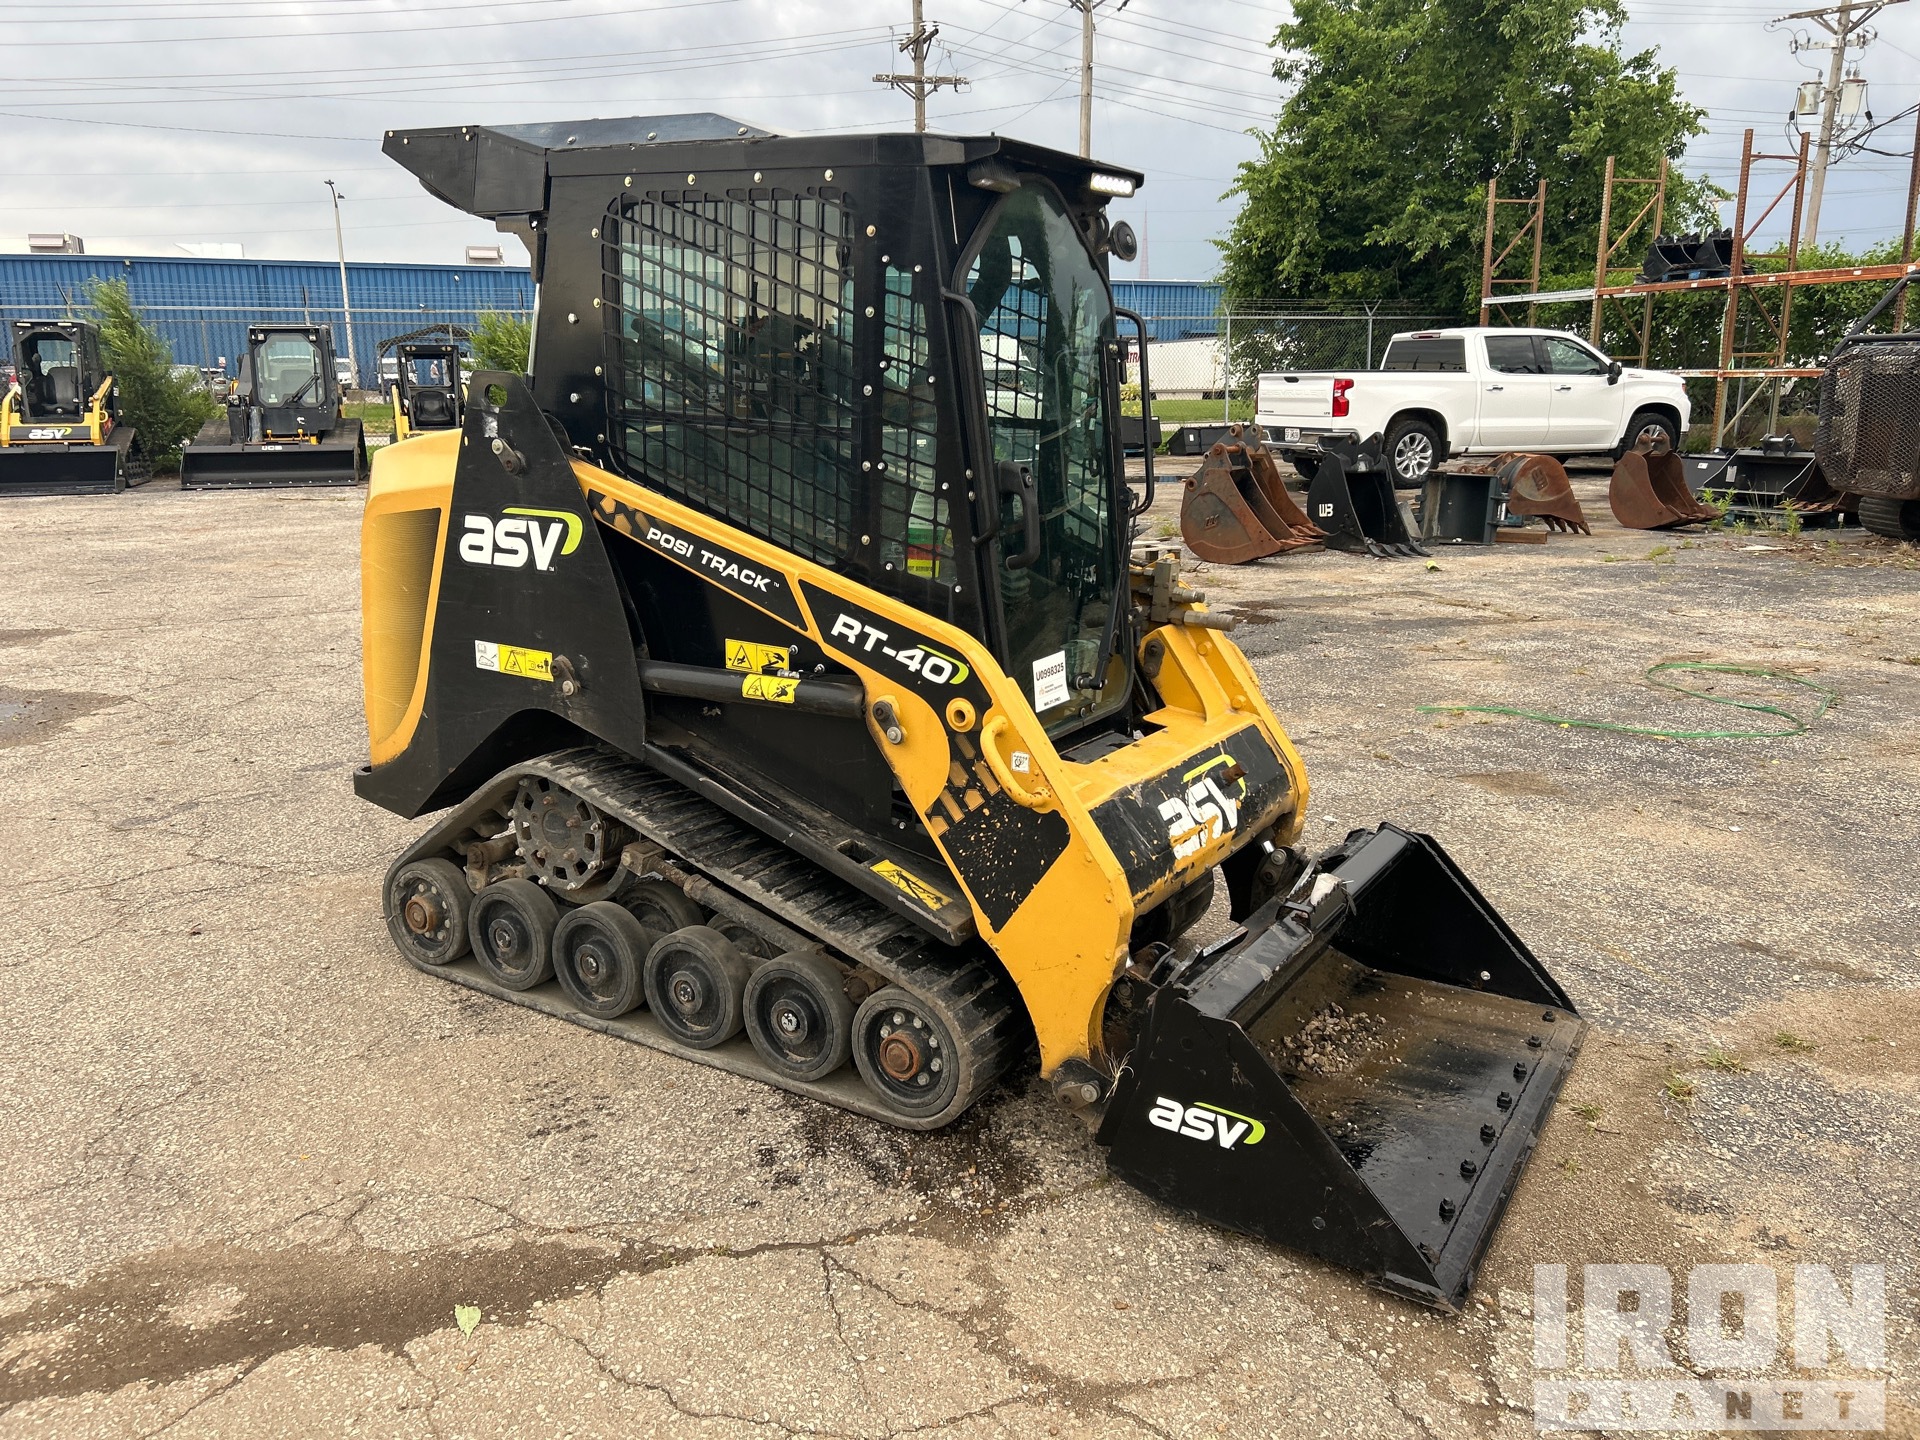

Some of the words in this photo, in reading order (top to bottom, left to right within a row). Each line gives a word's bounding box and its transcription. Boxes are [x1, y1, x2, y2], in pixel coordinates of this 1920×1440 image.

[646, 527, 695, 558] POSI
[700, 549, 771, 593] TRACK
[830, 613, 953, 684] RT-40
